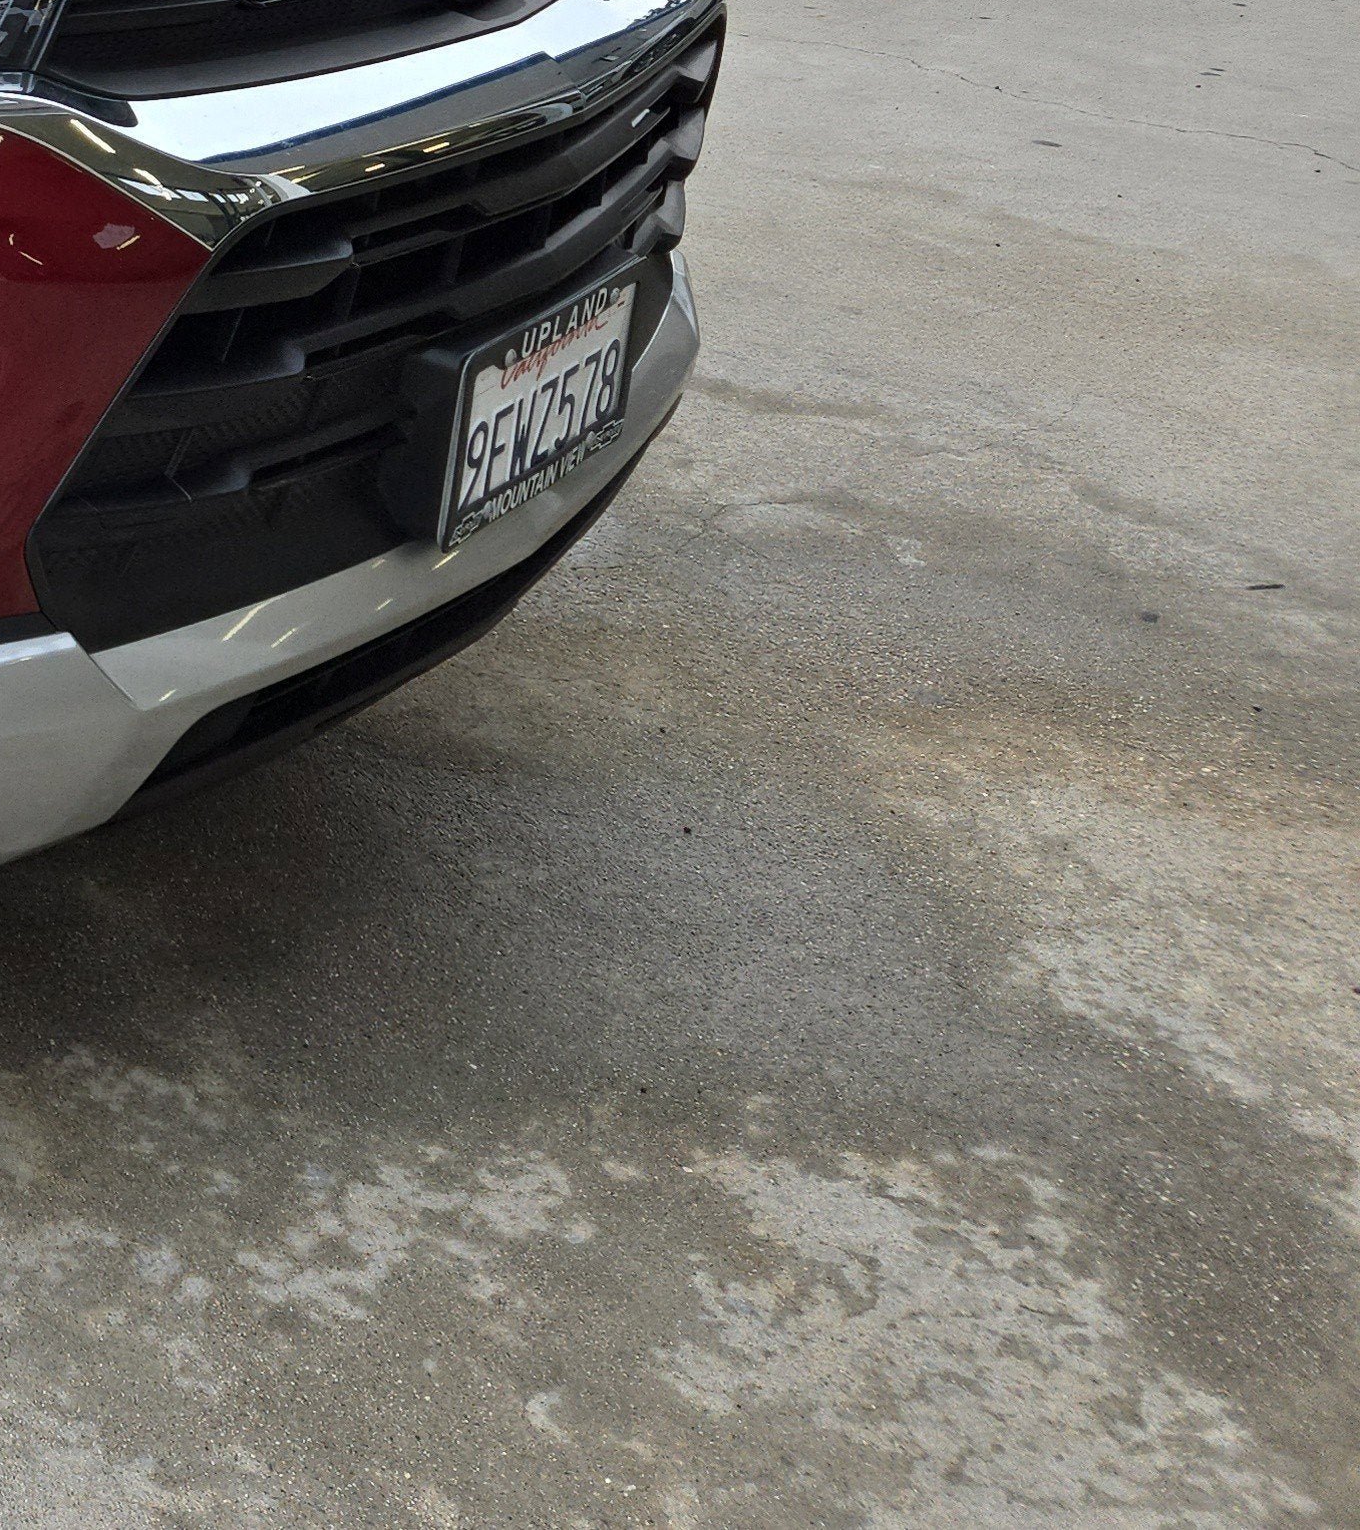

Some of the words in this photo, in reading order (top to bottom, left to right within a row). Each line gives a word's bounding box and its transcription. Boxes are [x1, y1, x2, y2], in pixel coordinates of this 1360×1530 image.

[521, 288, 608, 358] UPLAND
[457, 338, 622, 512] 9FWZ578
[487, 462, 558, 521] MOUNTAIN
